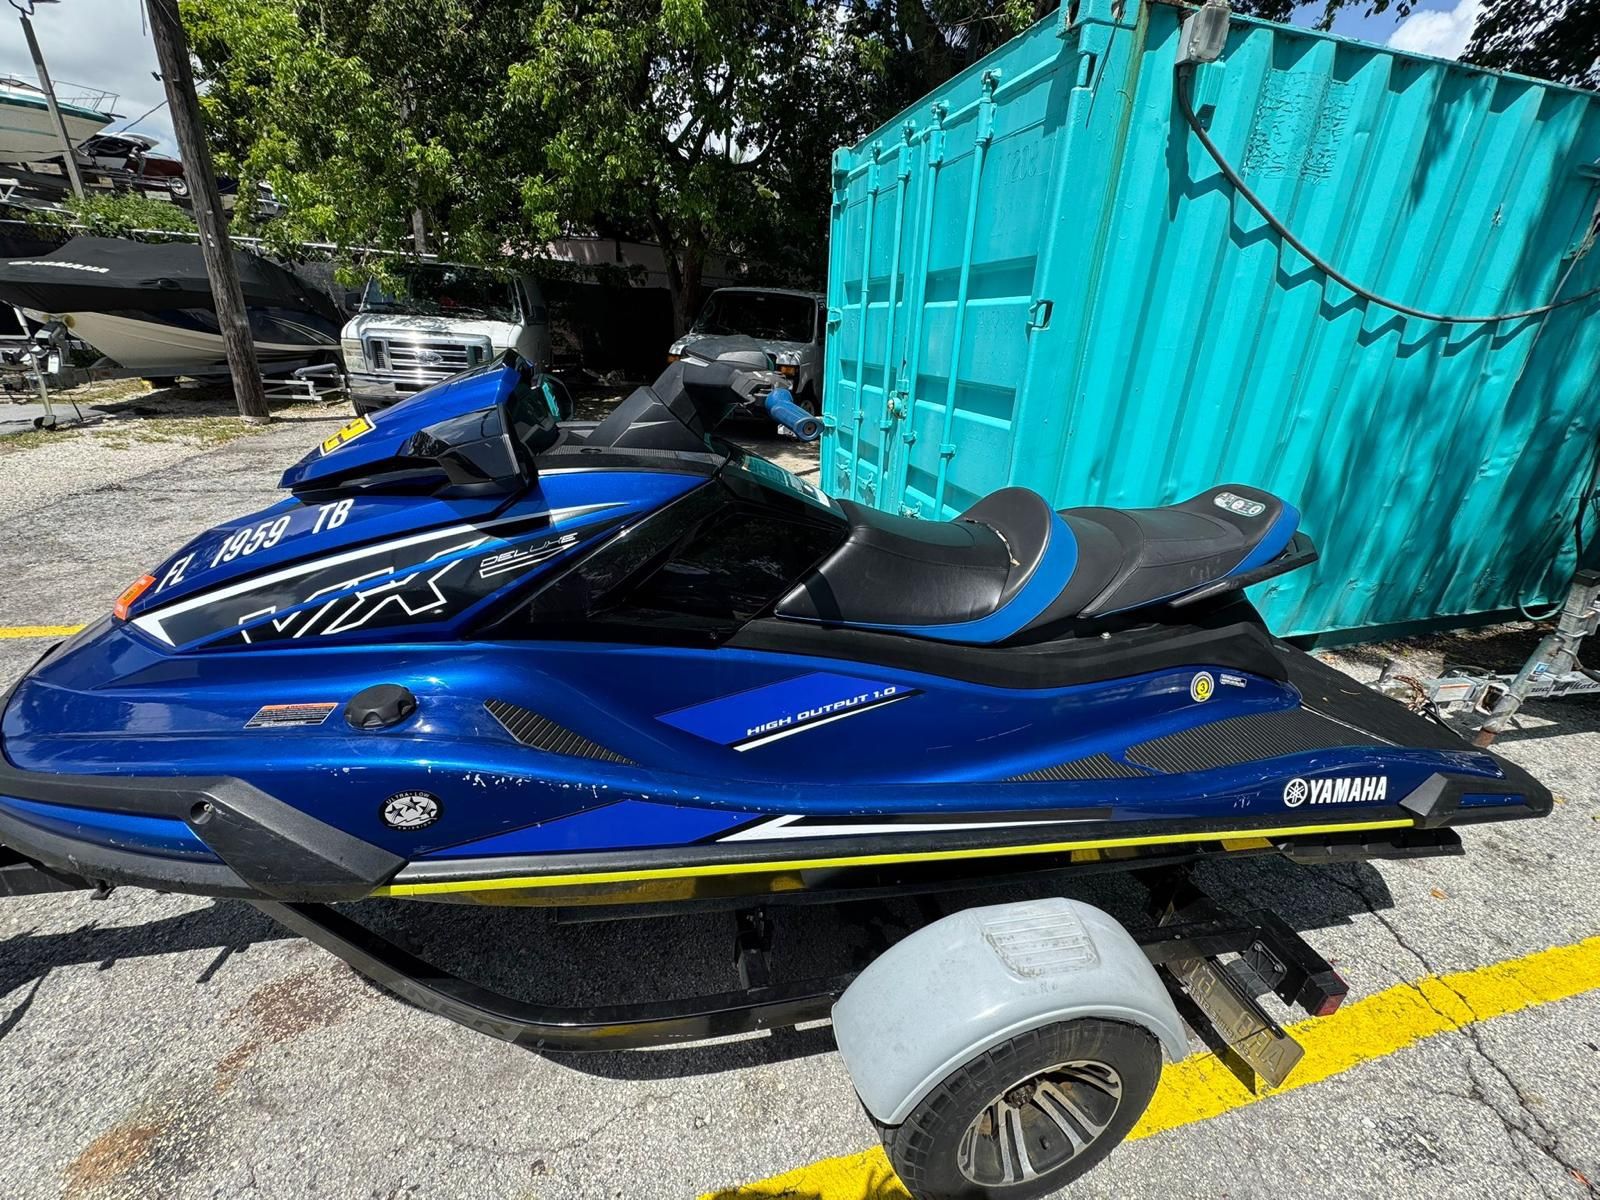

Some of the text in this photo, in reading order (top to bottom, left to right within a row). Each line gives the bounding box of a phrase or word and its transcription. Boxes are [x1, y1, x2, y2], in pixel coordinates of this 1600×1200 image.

[155, 545, 186, 593] FL
[210, 515, 292, 567] 1959
[312, 498, 355, 534] TB
[480, 532, 578, 568] DELUXE
[747, 686, 896, 736] HIGH OUTPUT 1.0
[1309, 776, 1387, 804] YAMAHA
